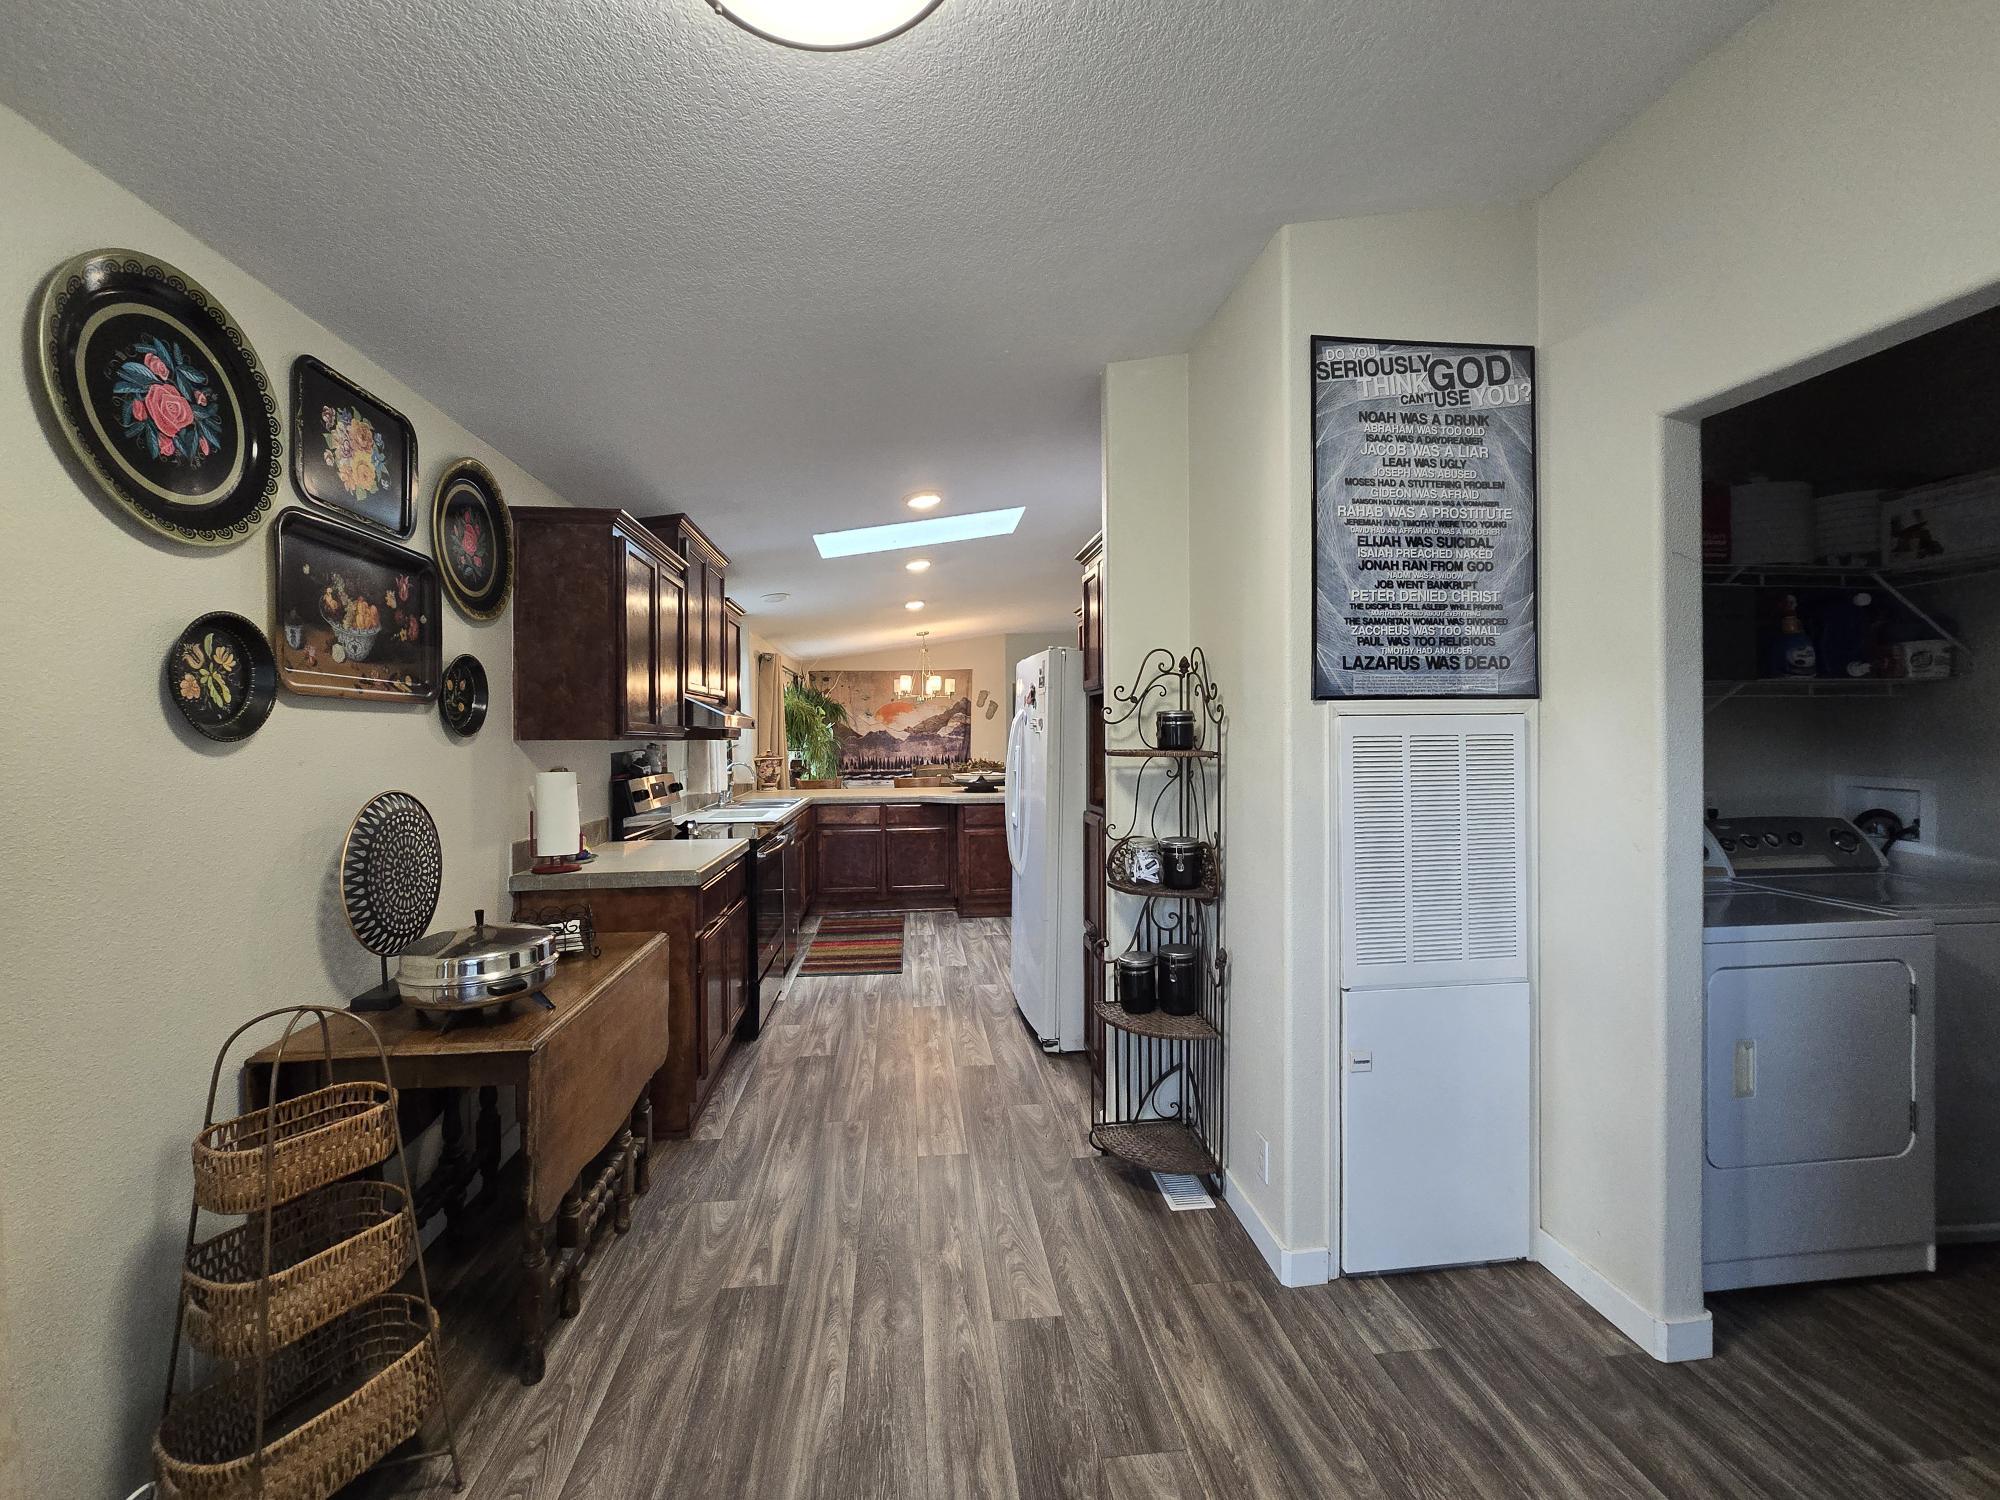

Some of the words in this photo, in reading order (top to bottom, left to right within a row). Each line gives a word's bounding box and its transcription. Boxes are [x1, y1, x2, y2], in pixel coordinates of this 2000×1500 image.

[1326, 348, 1345, 361] DO
[1350, 346, 1377, 360] YOU
[1316, 354, 1431, 381] SERIOUSLY
[1427, 355, 1511, 392] GOD
[1359, 374, 1430, 398] THINK
[1400, 392, 1434, 405] CAN'T
[1434, 389, 1471, 408] USE
[1471, 383, 1531, 406] YOU?
[1358, 411, 1396, 424] NOAH
[1400, 412, 1428, 425] WAS
[1432, 413, 1441, 425] A
[1445, 414, 1489, 427] DRUNK
[1364, 424, 1414, 434] ABRAHAM
[1417, 426, 1438, 435] WAS
[1441, 427, 1462, 436] TOO
[1464, 427, 1486, 437] OLD
[1366, 434, 1393, 443] ISAAC
[1395, 434, 1414, 444] WAS
[1416, 435, 1423, 444] A
[1425, 436, 1484, 446] DAYDREAMER
[1360, 443, 1407, 457] JACOB
[1411, 444, 1441, 458] WAS
[1444, 446, 1455, 459] A
[1459, 446, 1490, 460] LIAR
[1382, 457, 1412, 468] LEAH
[1414, 458, 1438, 469] WAS
[1440, 459, 1467, 470] UGLY
[1373, 468, 1412, 478] JOSEPH
[1413, 468, 1436, 479] WAS
[1438, 470, 1478, 480] ABUSED
[1345, 478, 1376, 487] MOSES
[1378, 479, 1397, 488] HAD
[1399, 480, 1406, 489] A
[1408, 480, 1462, 490] STUTTERING
[1464, 481, 1506, 490] PROBLEM
[1371, 488, 1412, 499] GIDEON
[1414, 489, 1438, 500] WAS
[1441, 490, 1480, 500] AFRAID
[1337, 505, 1384, 518] RAHAB
[1387, 507, 1416, 519] WAS
[1419, 507, 1429, 519] A
[1432, 507, 1513, 520] PROSTITUTE
[1344, 519, 1382, 527] JEREMIAH
[1383, 520, 1400, 528] AND
[1403, 520, 1436, 528] TIMOTHY
[1438, 520, 1460, 529] WERE
[1462, 521, 1478, 529] TOO
[1480, 521, 1507, 529] YOUNG
[1357, 535, 1401, 548] ELIJAH
[1405, 536, 1434, 549] WAS
[1436, 536, 1494, 549] SUICIDAL
[1357, 548, 1393, 559] ISAIAH
[1396, 548, 1453, 560] PREACHED
[1455, 549, 1494, 560] NAKED
[1358, 559, 1400, 572] JONAH
[1402, 560, 1428, 572] RAN
[1430, 561, 1464, 573] FROM
[1467, 561, 1495, 573] GOD
[1374, 580, 1395, 590] JOB
[1397, 581, 1425, 590] WENT
[1427, 581, 1478, 590] BANKRUPT
[1351, 589, 1396, 602] PETER
[1399, 590, 1448, 602] DENIED
[1451, 590, 1501, 603] CHRIST
[1350, 603, 1364, 611] THE
[1365, 603, 1401, 611] DISCIPLES
[1403, 603, 1420, 611] FELL
[1362, 618, 1410, 626] SAMARITAN
[1412, 618, 1445, 626] WOMAN
[1446, 618, 1465, 626] WAS
[1467, 618, 1508, 626] DIVORCED
[1351, 625, 1410, 636] ZACCHEUS
[1412, 625, 1436, 636] WAS
[1438, 625, 1462, 636] TOO
[1464, 625, 1501, 636] SMALL
[1357, 637, 1384, 646] PAUL
[1387, 637, 1410, 646] WAS
[1412, 637, 1436, 646] TOO
[1438, 637, 1496, 647] RELIGIOUS
[1380, 647, 1415, 656] TIMOTHY
[1416, 647, 1433, 655] HAD
[1434, 647, 1446, 655] AN
[1447, 647, 1473, 656] ULCER
[1342, 656, 1420, 671] LAZARUS
[1425, 656, 1460, 670] WAS
[1464, 656, 1511, 670] DEAD
